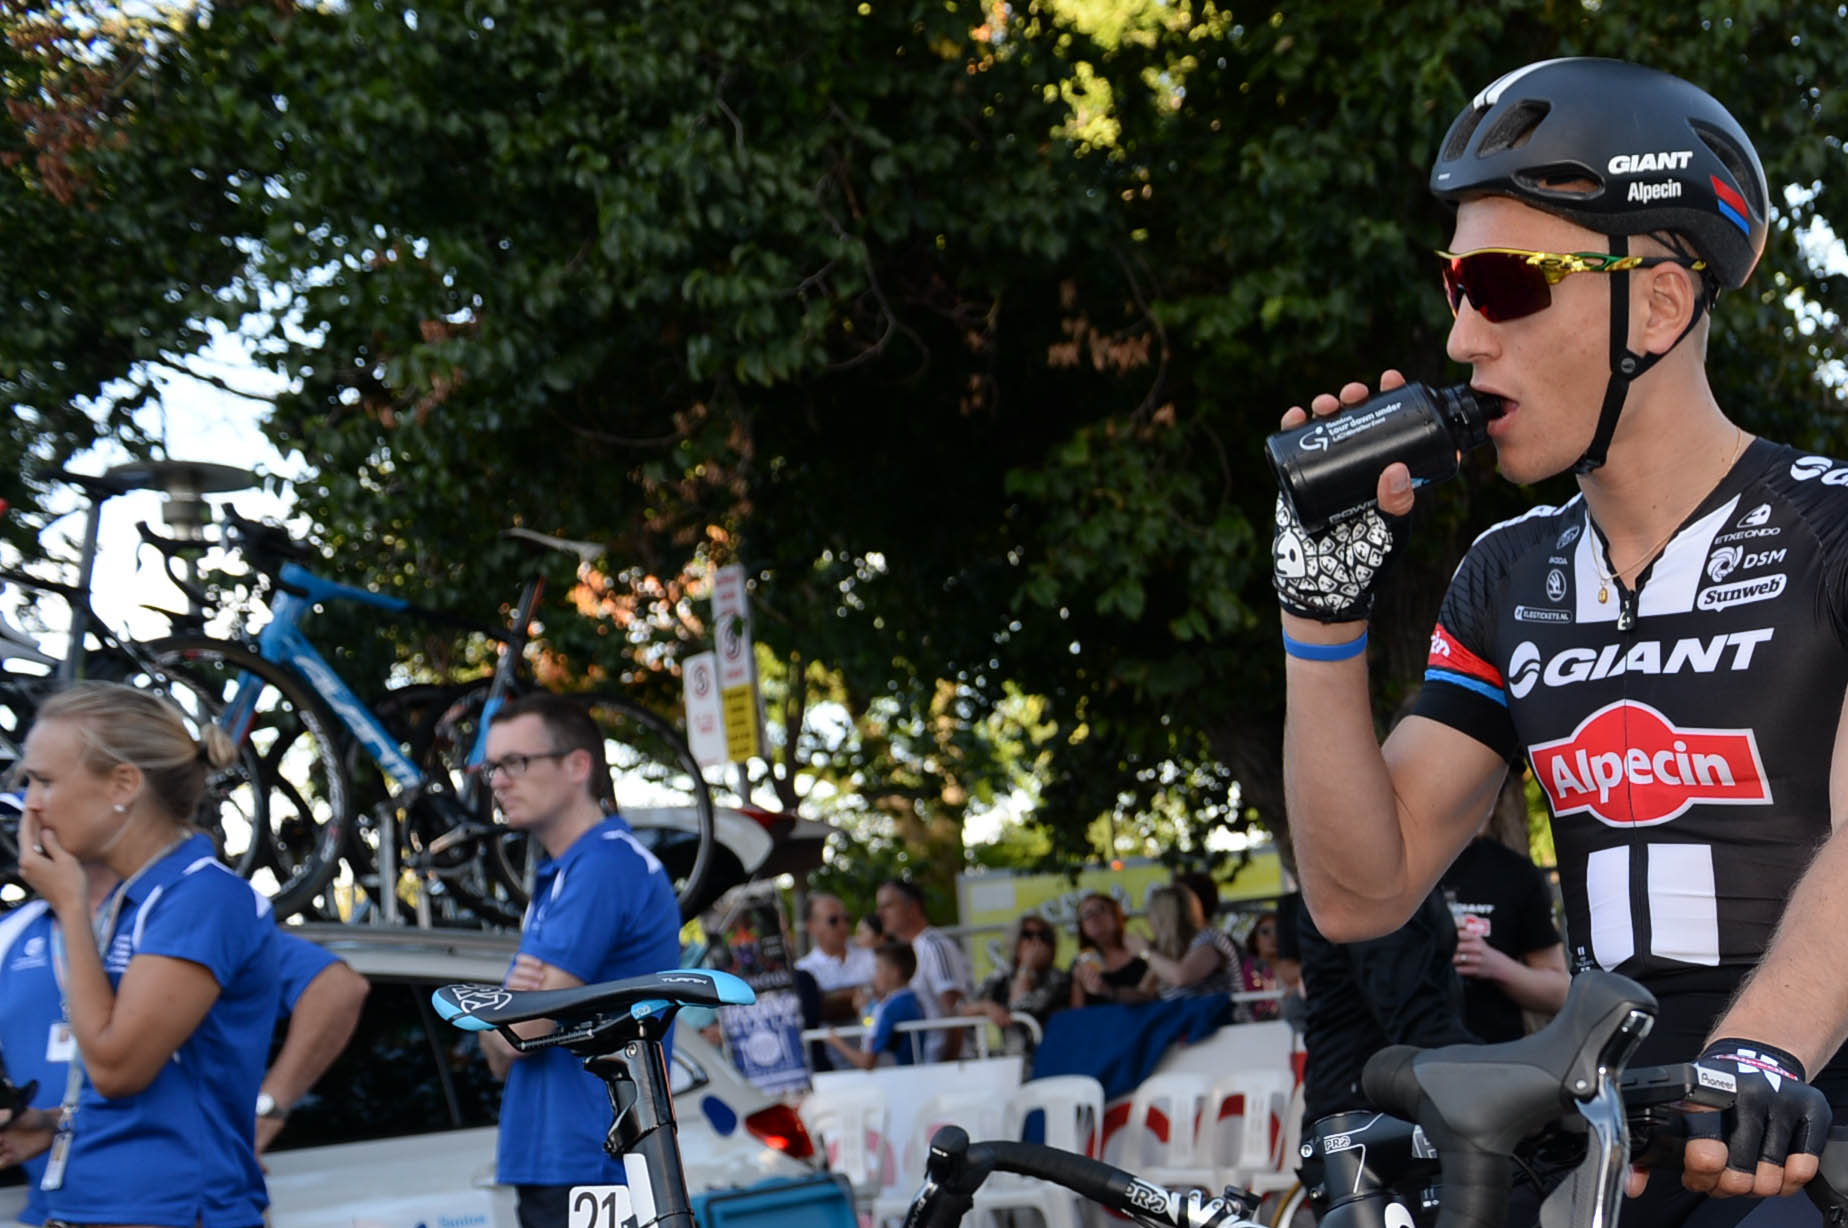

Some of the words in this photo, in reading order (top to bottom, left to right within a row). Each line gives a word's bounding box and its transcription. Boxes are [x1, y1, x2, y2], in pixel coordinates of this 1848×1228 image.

[1608, 151, 1693, 174] GIANT
[1627, 178, 1682, 204] Alpecin
[1328, 421, 1352, 436] tour
[1350, 413, 1375, 429] down
[1374, 402, 1401, 418] under
[1714, 528, 1781, 544] ETXEONDO
[1743, 549, 1787, 569] DSM
[1704, 579, 1781, 605] Sunweb
[1544, 628, 1774, 687] GIANT
[1551, 740, 1735, 803] Alpecin
[1701, 1073, 1735, 1090] Pioneer
